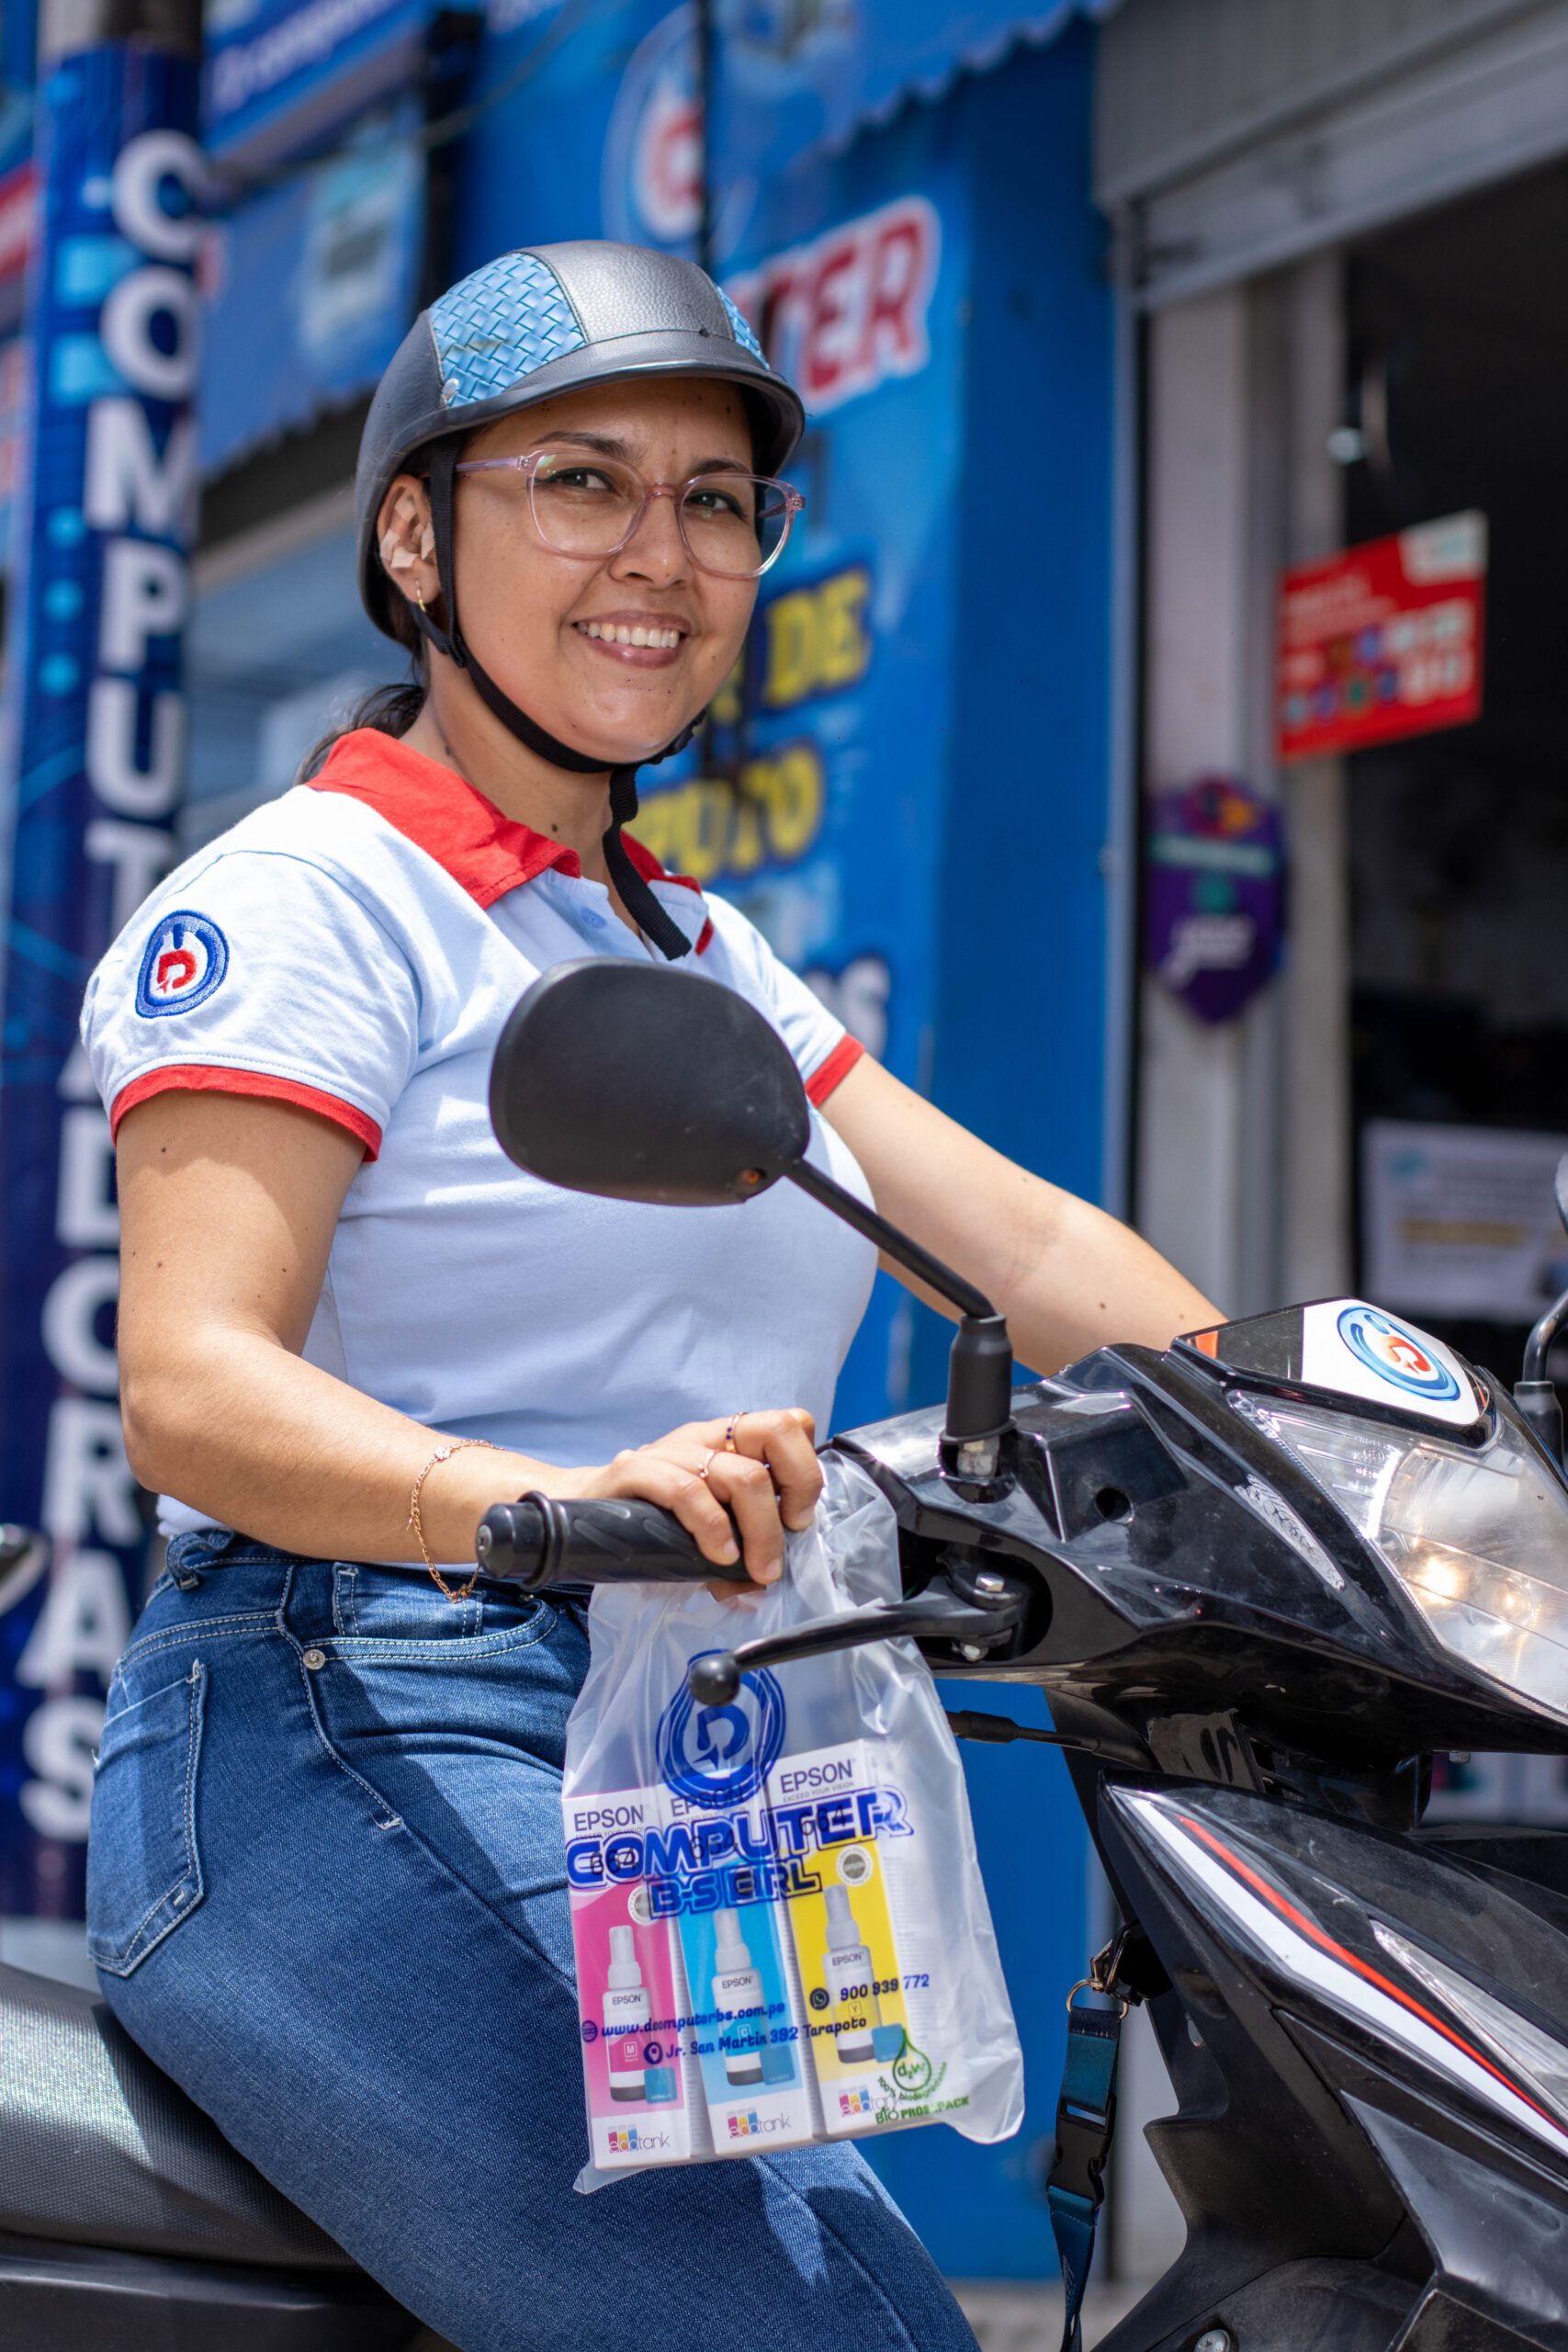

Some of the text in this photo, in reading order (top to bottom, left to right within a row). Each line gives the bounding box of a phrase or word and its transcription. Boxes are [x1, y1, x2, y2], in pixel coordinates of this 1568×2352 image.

[18, 129, 205, 1841] COMPUTDORAS
[781, 1759, 852, 1793] EPSON
[574, 1804, 644, 1831] EPSON
[799, 1804, 847, 1837] 664
[566, 1785, 914, 1889] COMPUTER
[724, 1855, 823, 1911] EIRL
[832, 1953, 862, 1966] EPSON
[722, 1976, 751, 1989] EPSON
[840, 1973, 930, 2001] 900 939 772
[612, 1994, 641, 2005] EPSON
[666, 2044, 686, 2058] Jr.
[691, 2041, 715, 2055] San
[718, 2030, 767, 2051] Martin
[802, 2017, 866, 2038] Tarapoto
